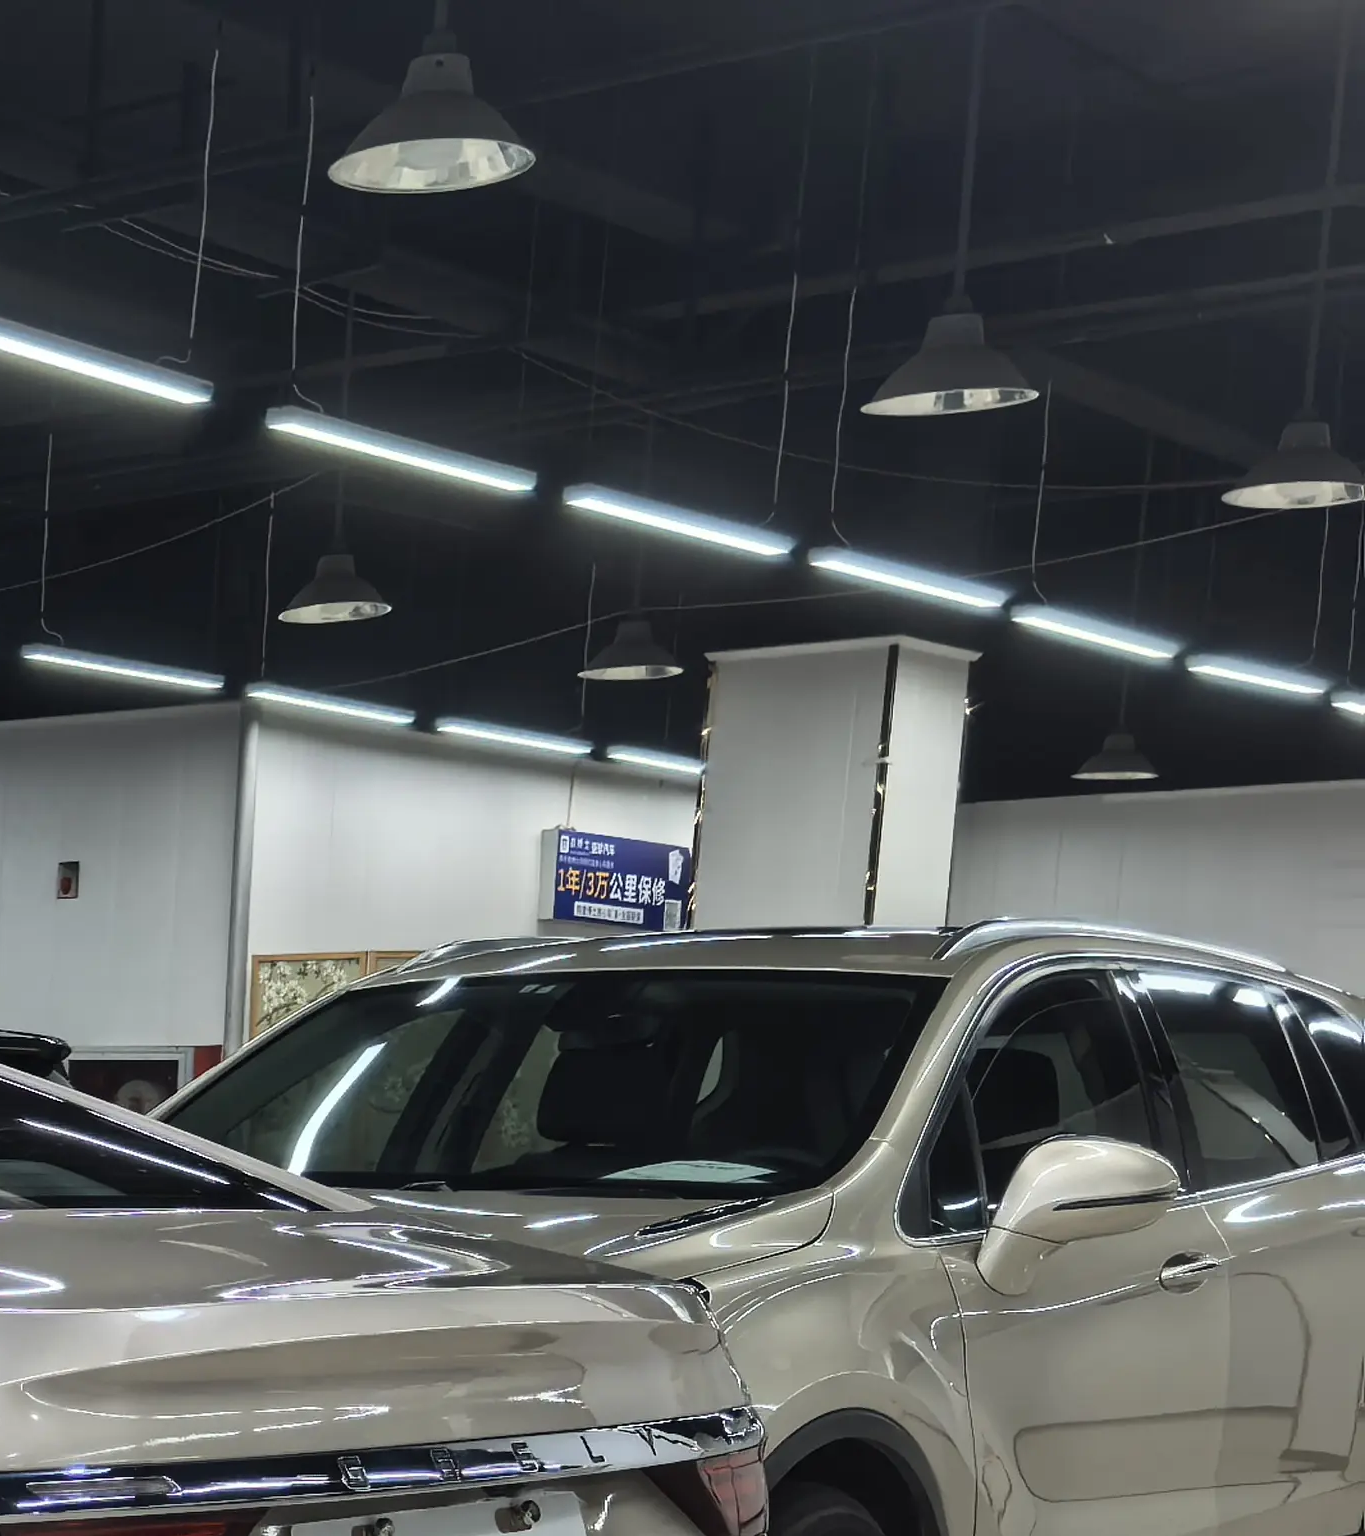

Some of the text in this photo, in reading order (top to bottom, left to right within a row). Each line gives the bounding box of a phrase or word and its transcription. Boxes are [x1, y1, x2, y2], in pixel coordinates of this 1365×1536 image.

[556, 867, 666, 906] 1年/3万公里保修
[338, 1426, 703, 1492] GEELY
